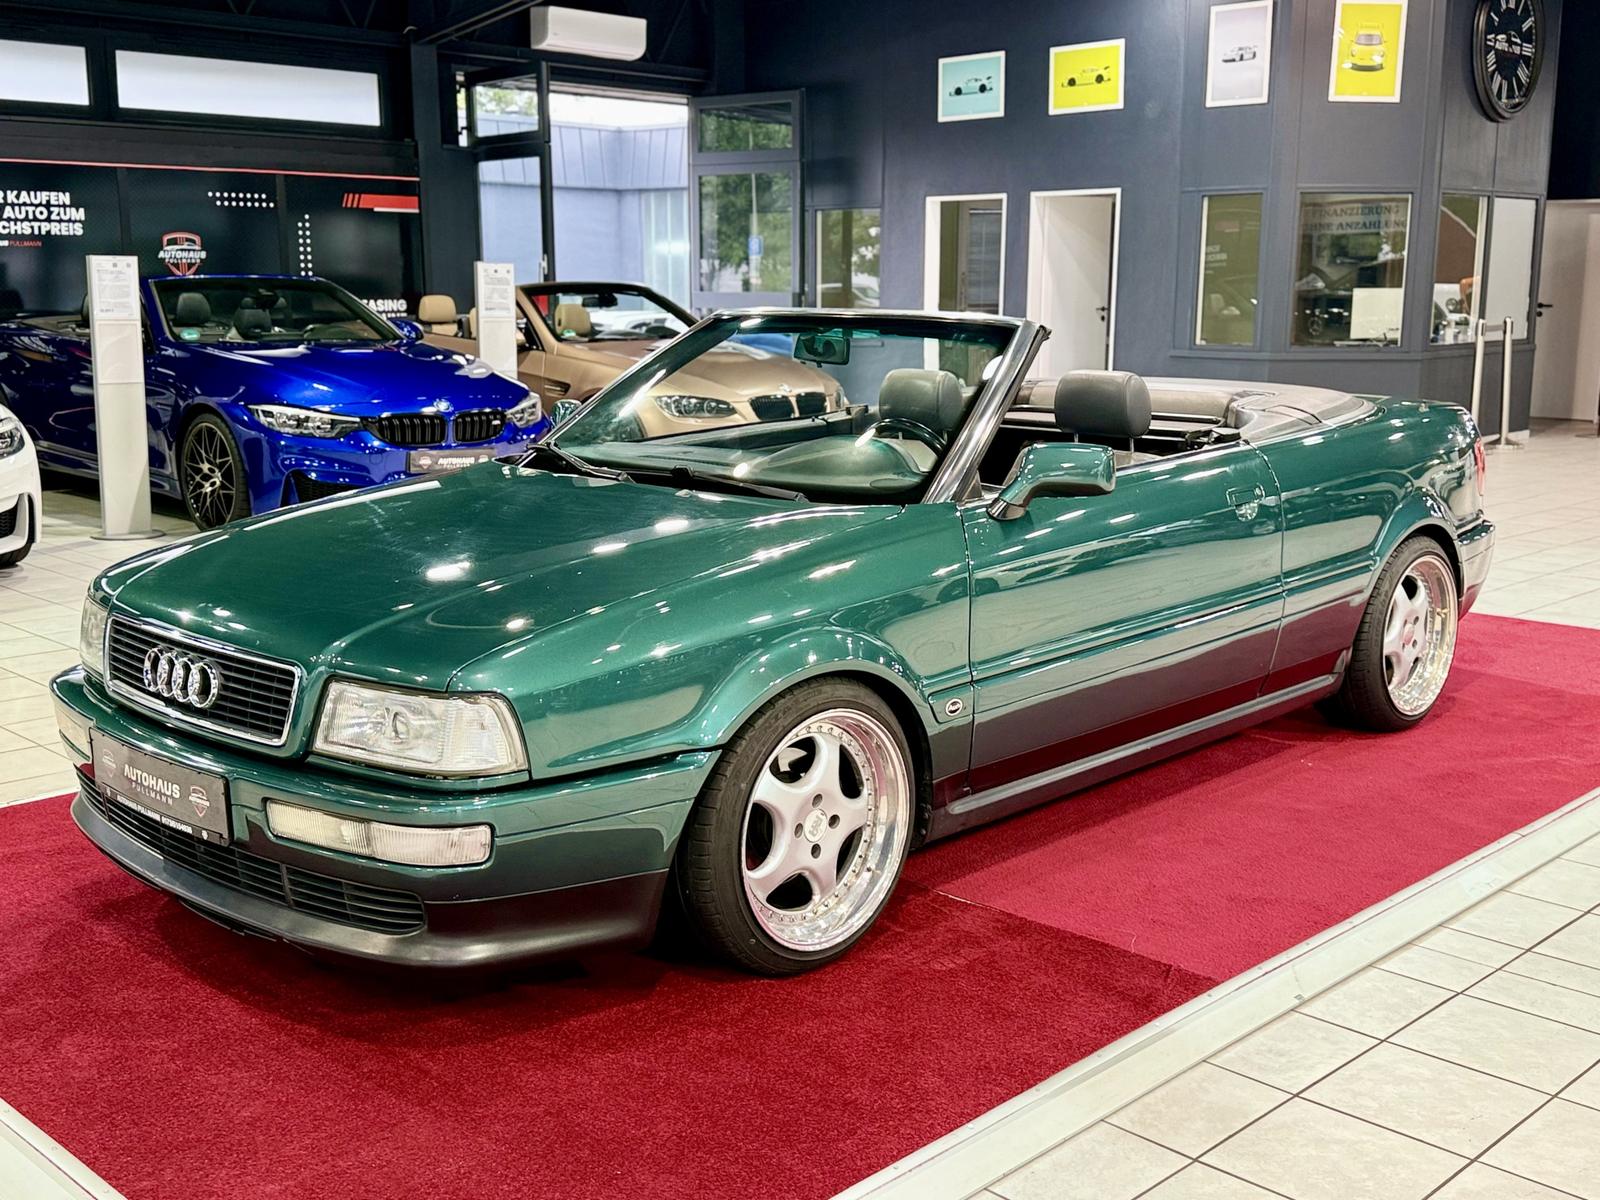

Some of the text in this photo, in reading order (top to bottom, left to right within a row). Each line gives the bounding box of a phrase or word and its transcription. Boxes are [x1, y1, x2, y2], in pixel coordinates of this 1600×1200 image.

[7, 190, 70, 205] KAUFEN
[3, 206, 85, 221] AUTO ZUM
[158, 250, 207, 259] AUTOHAUS
[124, 764, 181, 799] AUTOHAUS
[131, 781, 173, 806] PULLMANN
